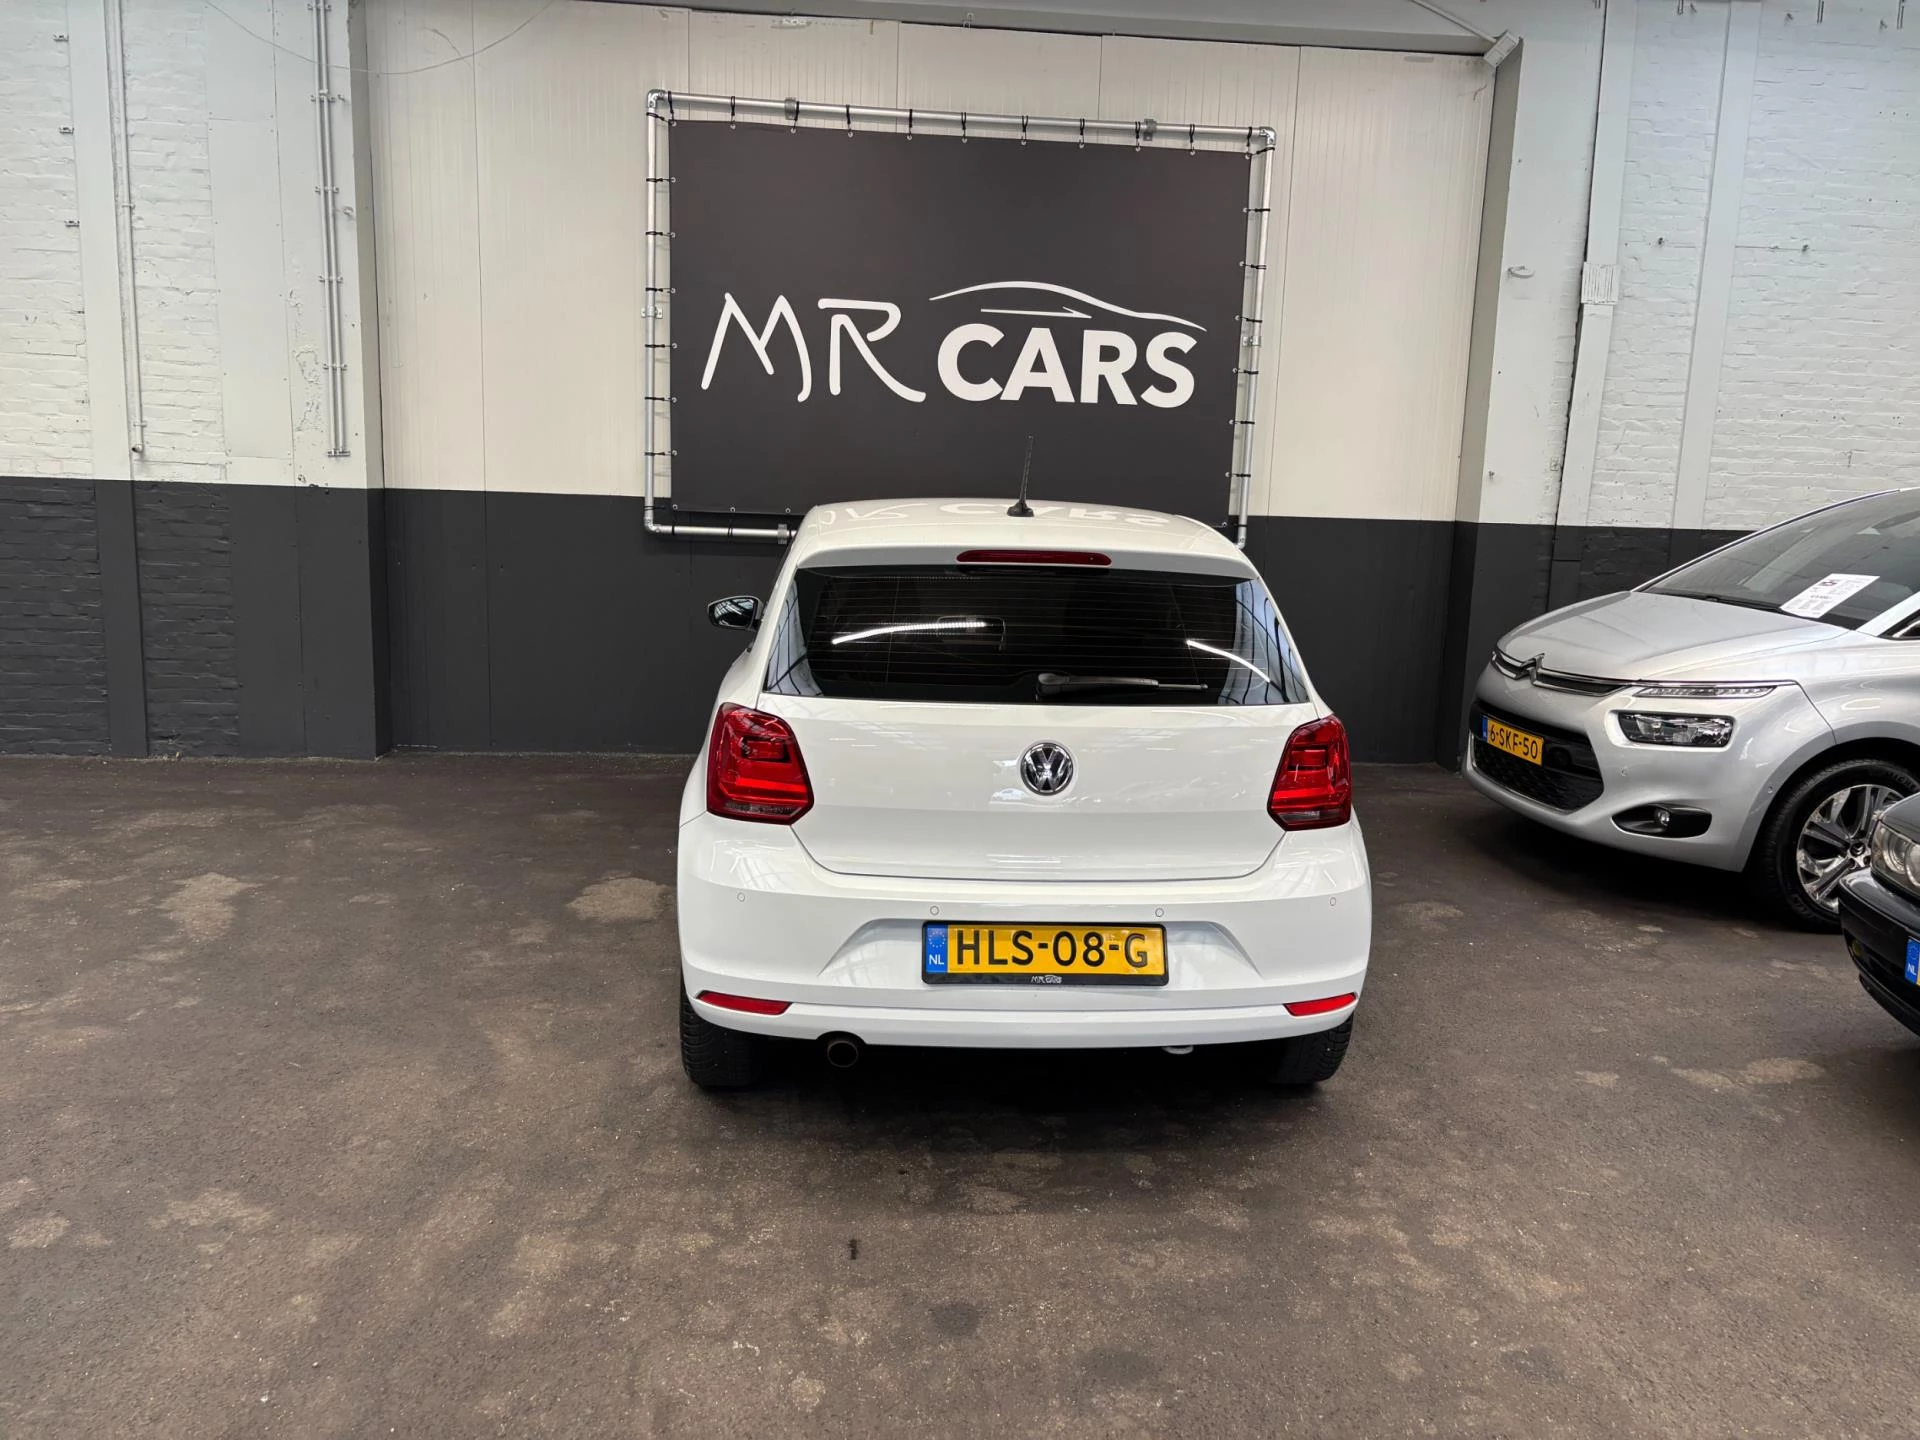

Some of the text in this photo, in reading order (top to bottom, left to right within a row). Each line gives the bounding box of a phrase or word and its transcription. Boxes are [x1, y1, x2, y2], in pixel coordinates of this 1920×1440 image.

[701, 292, 1198, 409] MR CARS
[1490, 724, 1538, 759] 6-SKF-50
[928, 954, 945, 965] NL
[957, 930, 1148, 968] HLS-08-G
[1907, 963, 1916, 976] NL
